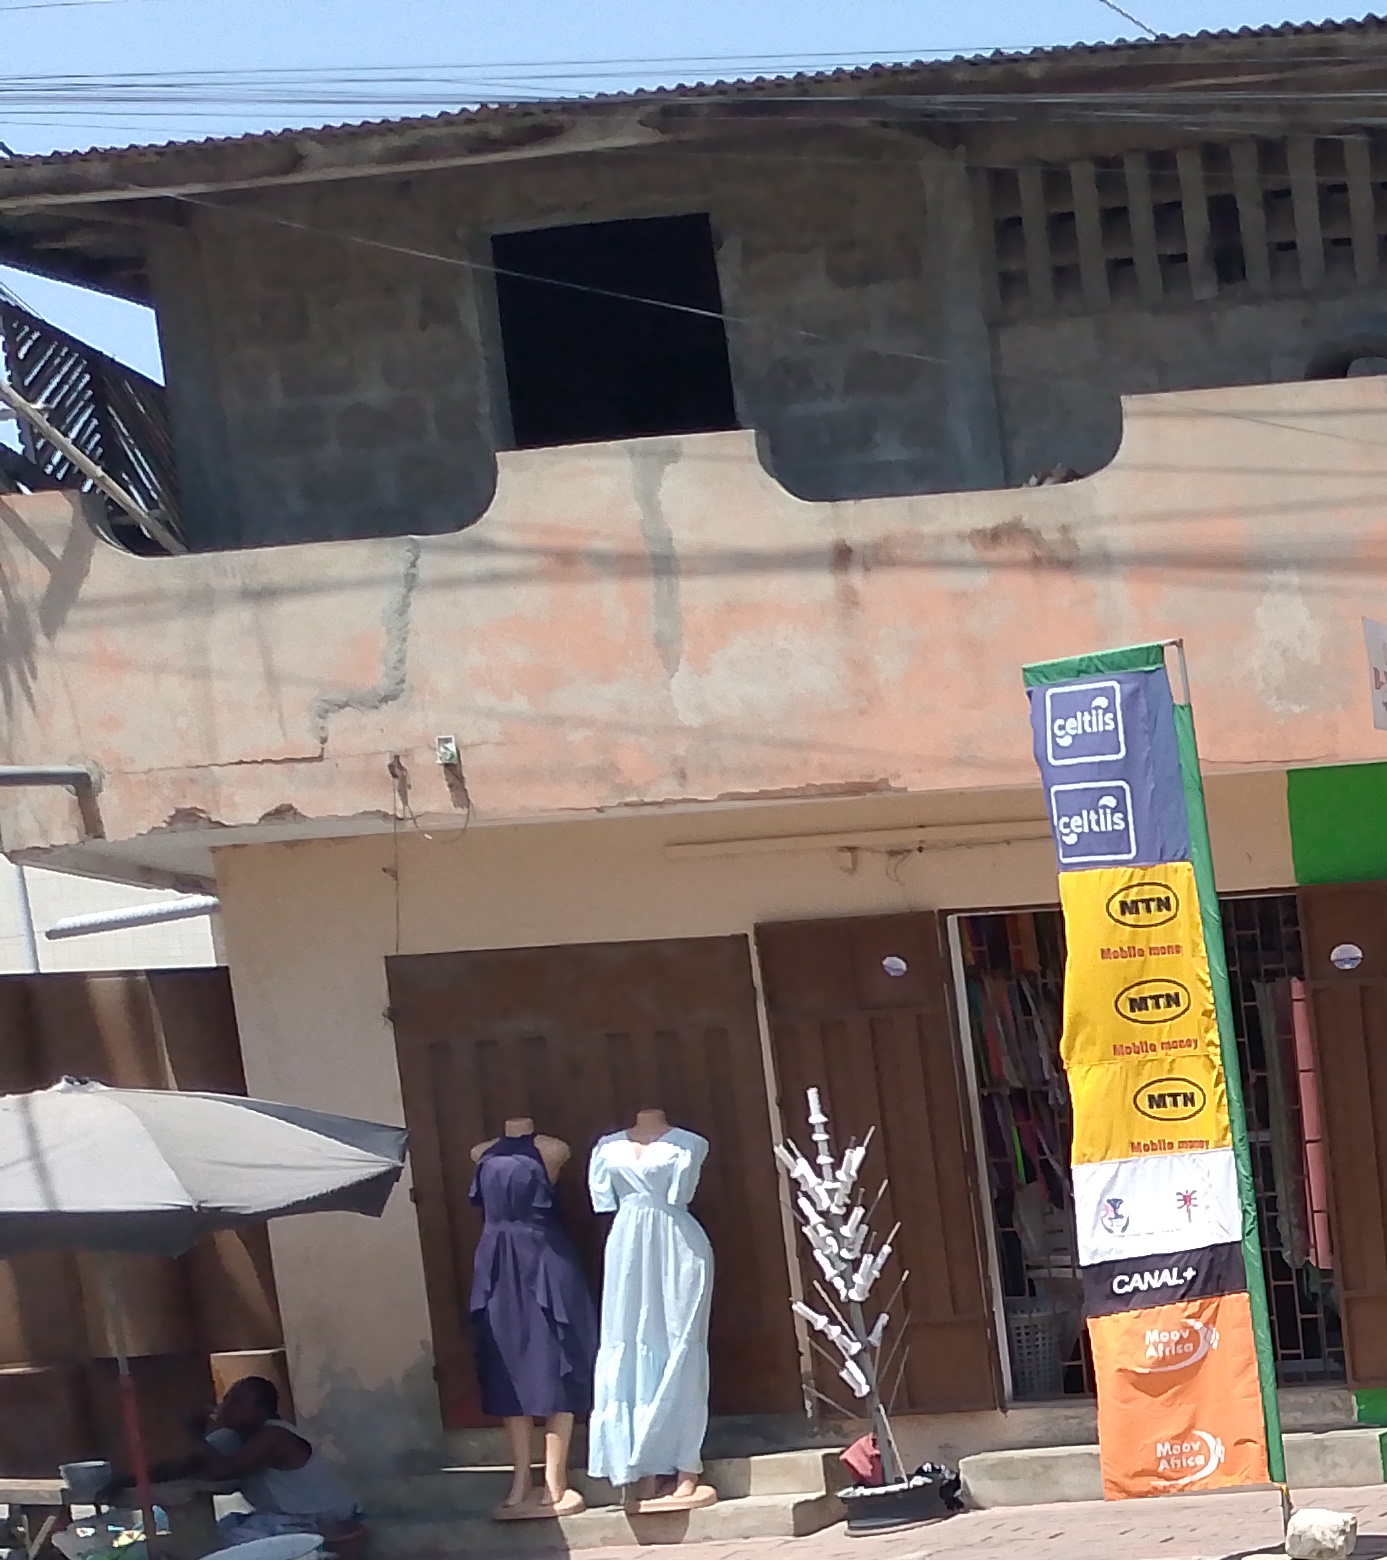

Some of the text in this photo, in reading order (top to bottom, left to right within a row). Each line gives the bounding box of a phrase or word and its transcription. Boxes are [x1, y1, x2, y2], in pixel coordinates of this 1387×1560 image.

[1119, 896, 1172, 918] MTN
[1100, 945, 1145, 961] Mobile
[1128, 991, 1181, 1014] MTN
[1112, 1040, 1157, 1056] Mobile
[1147, 1092, 1196, 1110] MTN
[1130, 1138, 1175, 1154] Mobile
[1112, 1267, 1197, 1294] CANAL+
[1145, 1327, 1190, 1345] Moov
[1145, 1341, 1194, 1359] Africa
[1156, 1440, 1201, 1458] Moov
[1158, 1453, 1205, 1472] Africa
